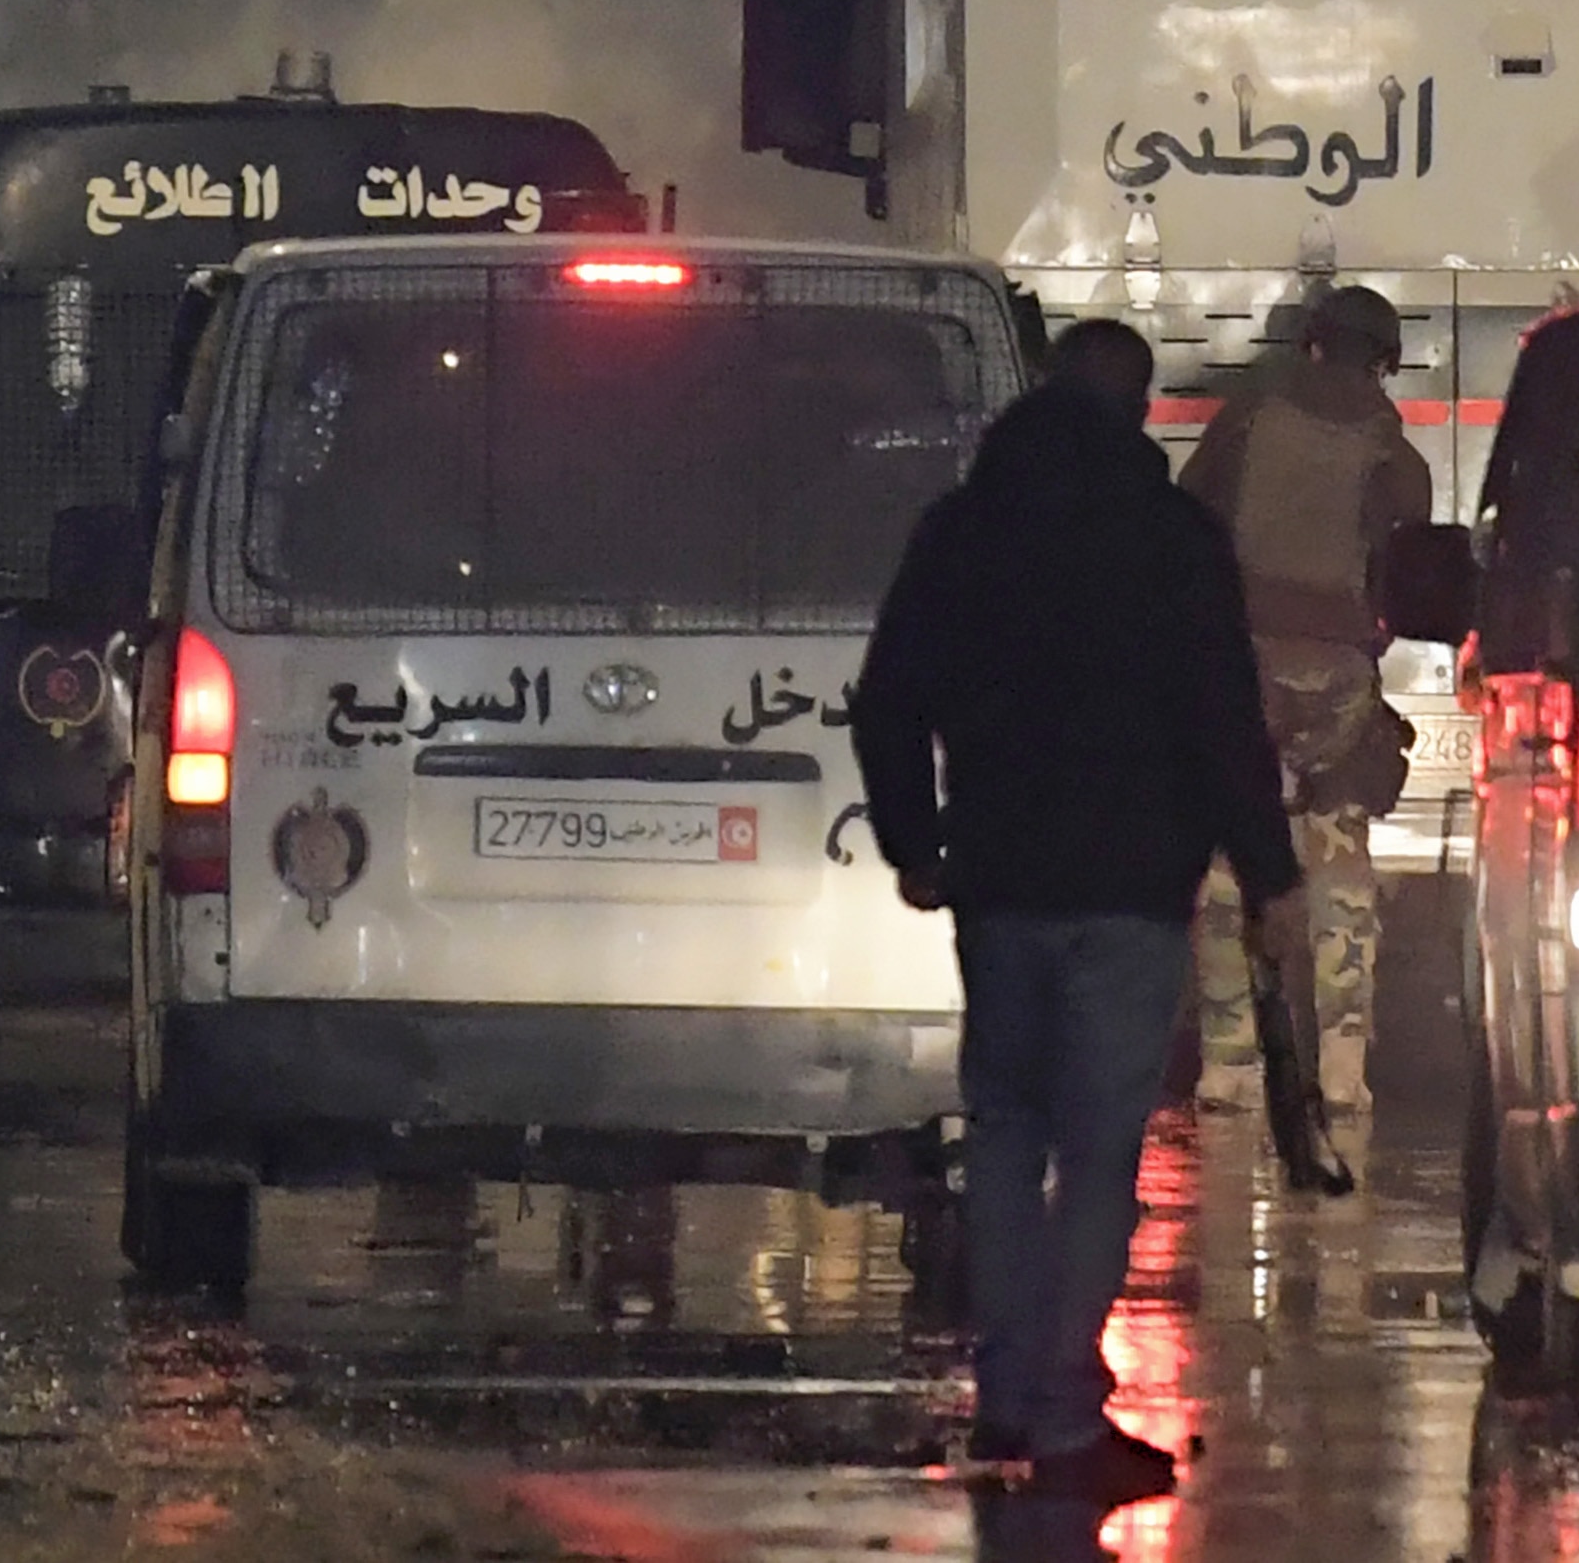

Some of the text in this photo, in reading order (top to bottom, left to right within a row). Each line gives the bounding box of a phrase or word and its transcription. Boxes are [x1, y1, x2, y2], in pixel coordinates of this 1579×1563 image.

[1104, 73, 1434, 206] الوطني
[85, 160, 544, 235] وحدات الطلائع
[324, 664, 551, 748] السريع
[487, 809, 608, 849] 27799
